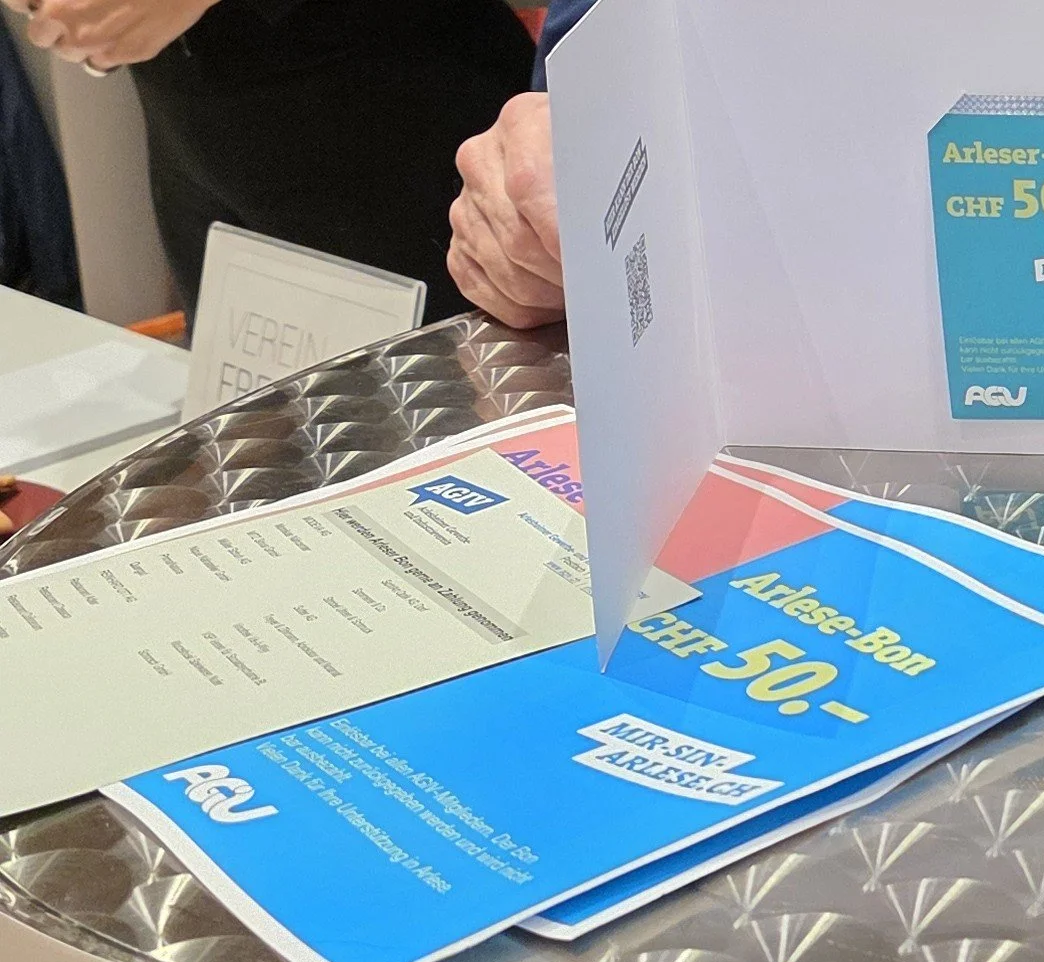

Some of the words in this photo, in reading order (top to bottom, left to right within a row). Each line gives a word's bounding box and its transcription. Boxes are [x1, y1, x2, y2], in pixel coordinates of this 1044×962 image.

[946, 196, 1005, 218] CHF
[424, 482, 495, 507] AGIV
[626, 611, 729, 659] CHF
[728, 571, 937, 677] Arlese-Bon
[599, 721, 727, 768] MIR-SIN-
[596, 747, 761, 799] ARLESE.CH
